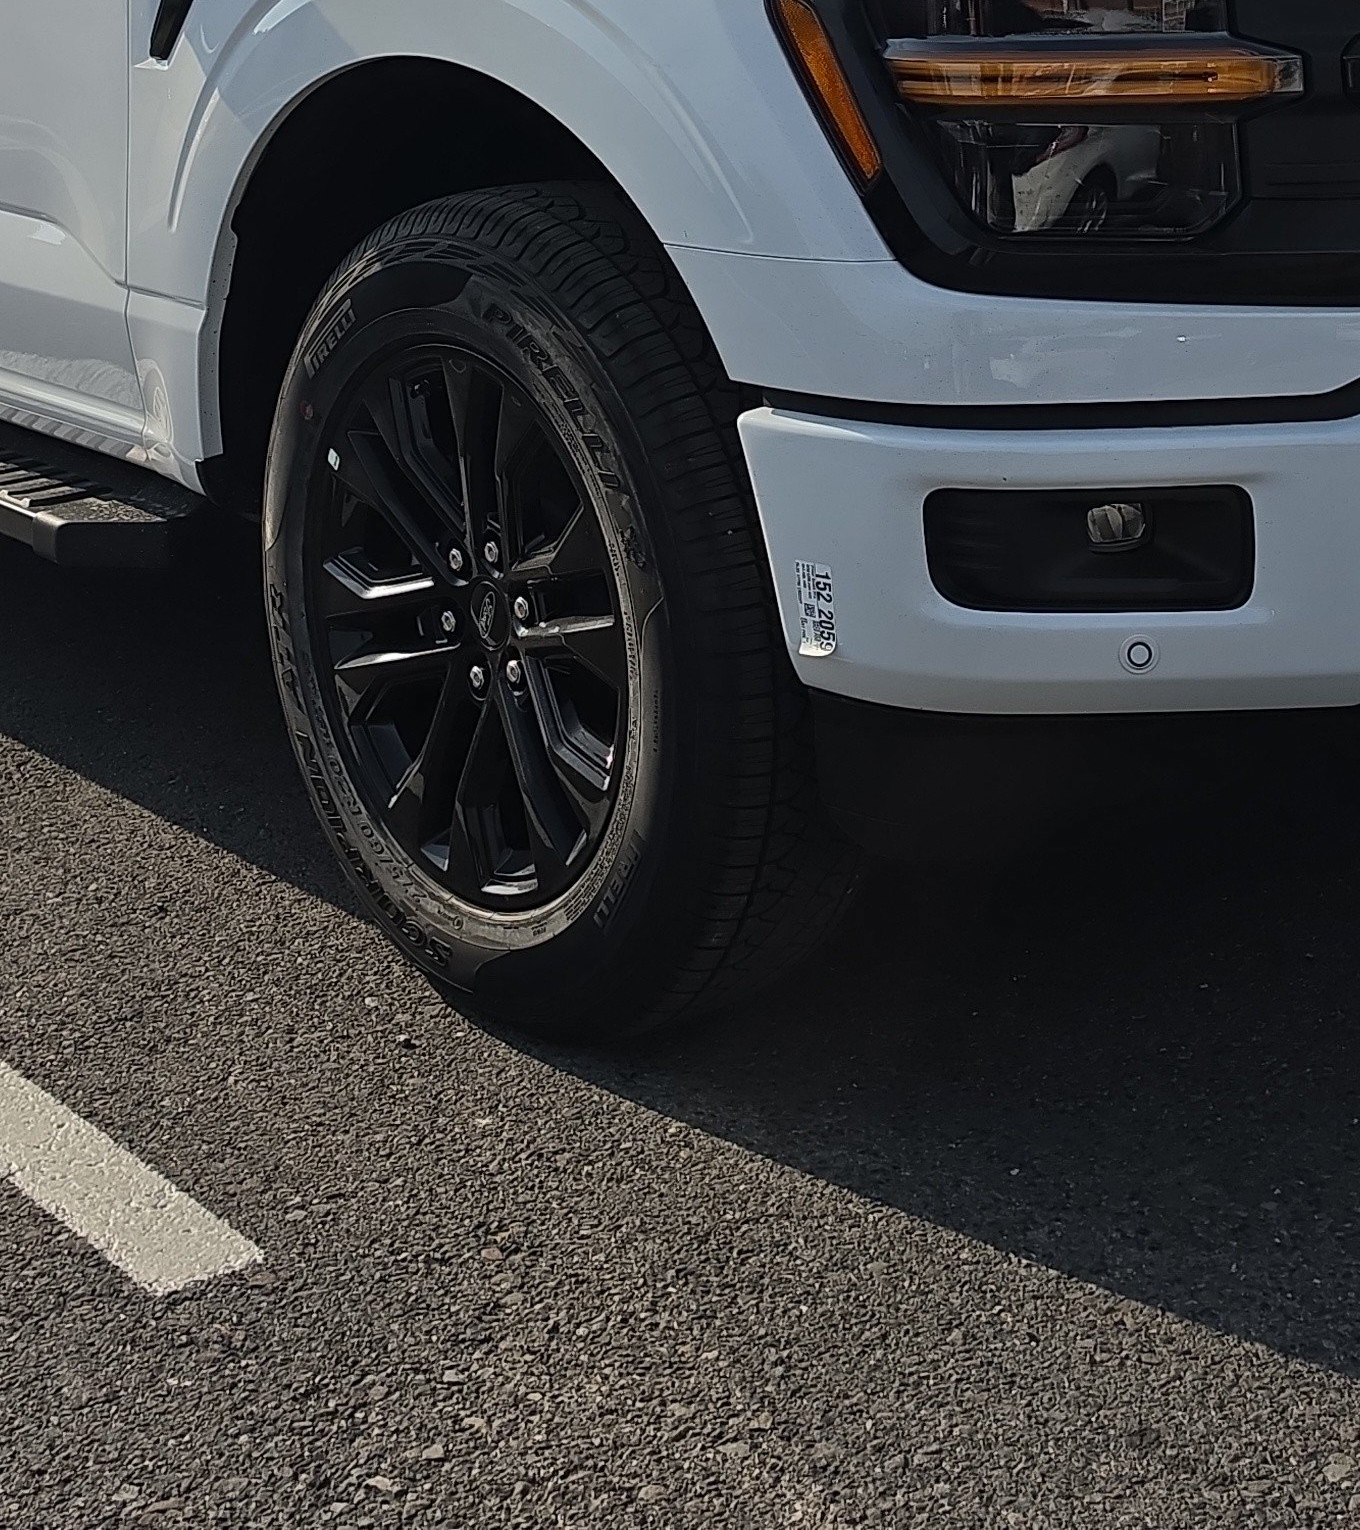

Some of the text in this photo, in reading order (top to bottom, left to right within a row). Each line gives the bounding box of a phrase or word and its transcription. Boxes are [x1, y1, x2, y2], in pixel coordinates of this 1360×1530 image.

[303, 298, 358, 379] PIRELLI
[482, 301, 622, 489] PIRELLI
[815, 571, 836, 652] 152 2059
[295, 730, 454, 968] SCORPION
